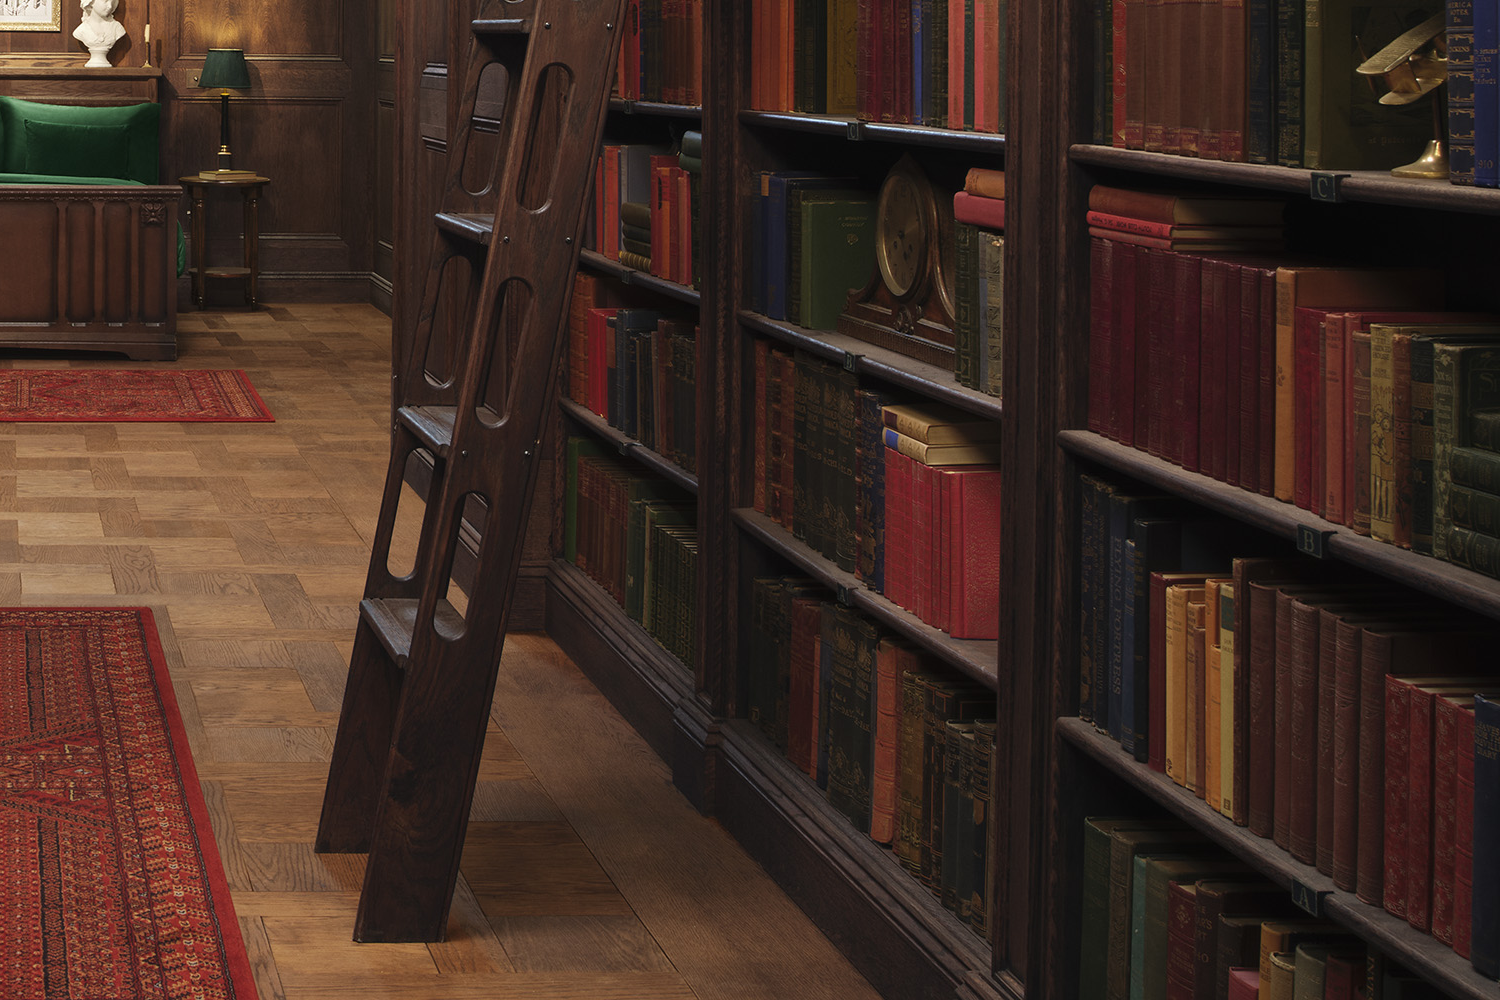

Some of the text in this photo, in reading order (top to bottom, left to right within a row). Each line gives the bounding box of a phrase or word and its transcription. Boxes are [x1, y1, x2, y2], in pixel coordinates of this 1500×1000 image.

[849, 124, 855, 139] C
[1316, 177, 1328, 199] C
[1302, 530, 1314, 552] B
[1111, 537, 1125, 696] FLYING FORTRESS
[1298, 887, 1310, 911] A
